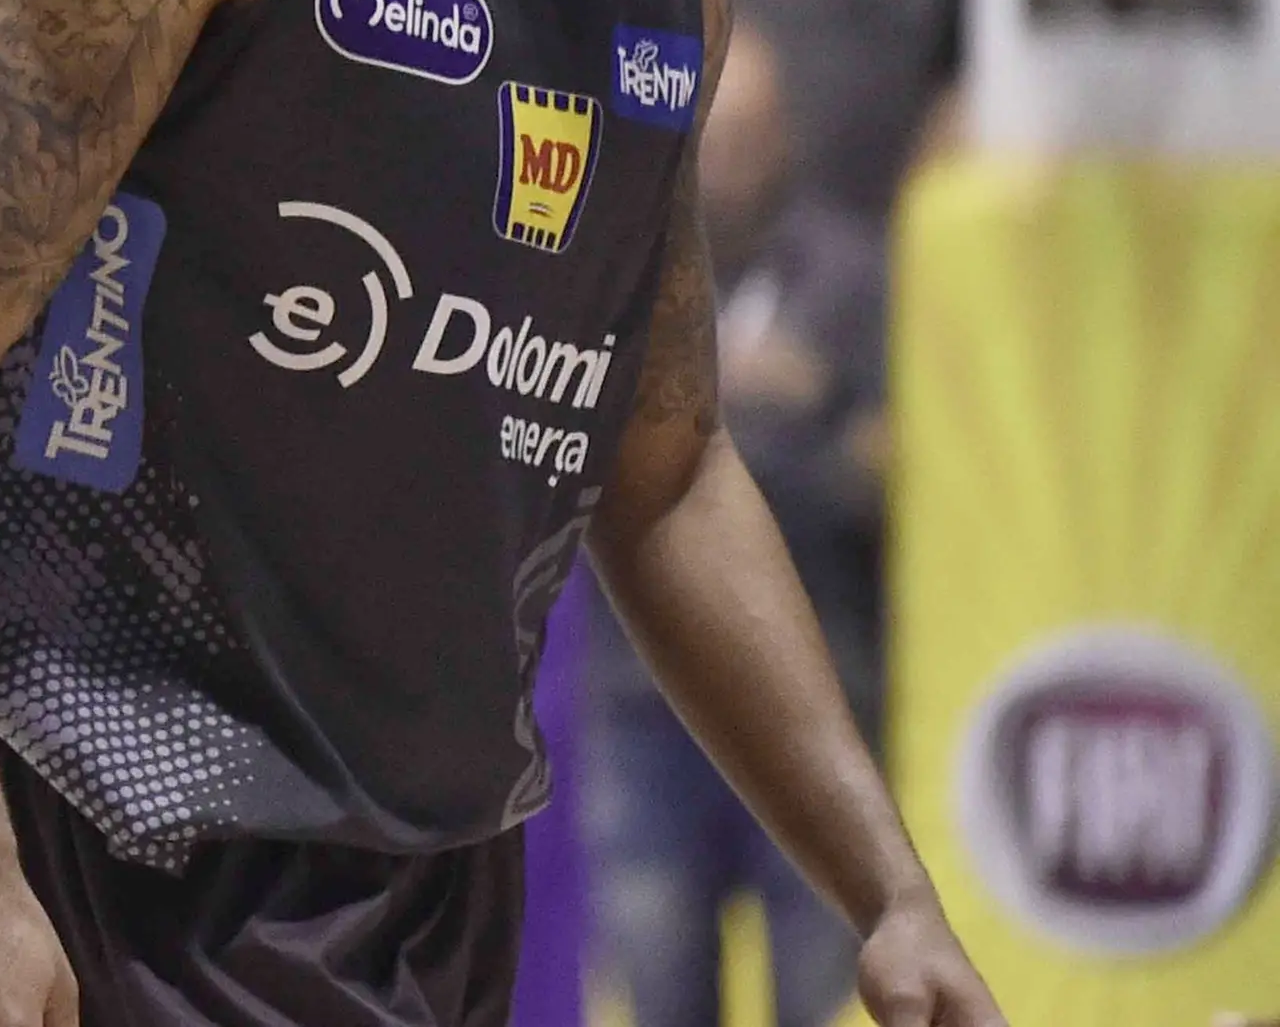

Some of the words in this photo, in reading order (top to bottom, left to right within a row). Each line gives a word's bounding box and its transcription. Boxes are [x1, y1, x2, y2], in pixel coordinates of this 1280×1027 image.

[617, 44, 697, 113] TRENTIN
[518, 133, 581, 195] MD
[43, 204, 132, 460] TRENTINO
